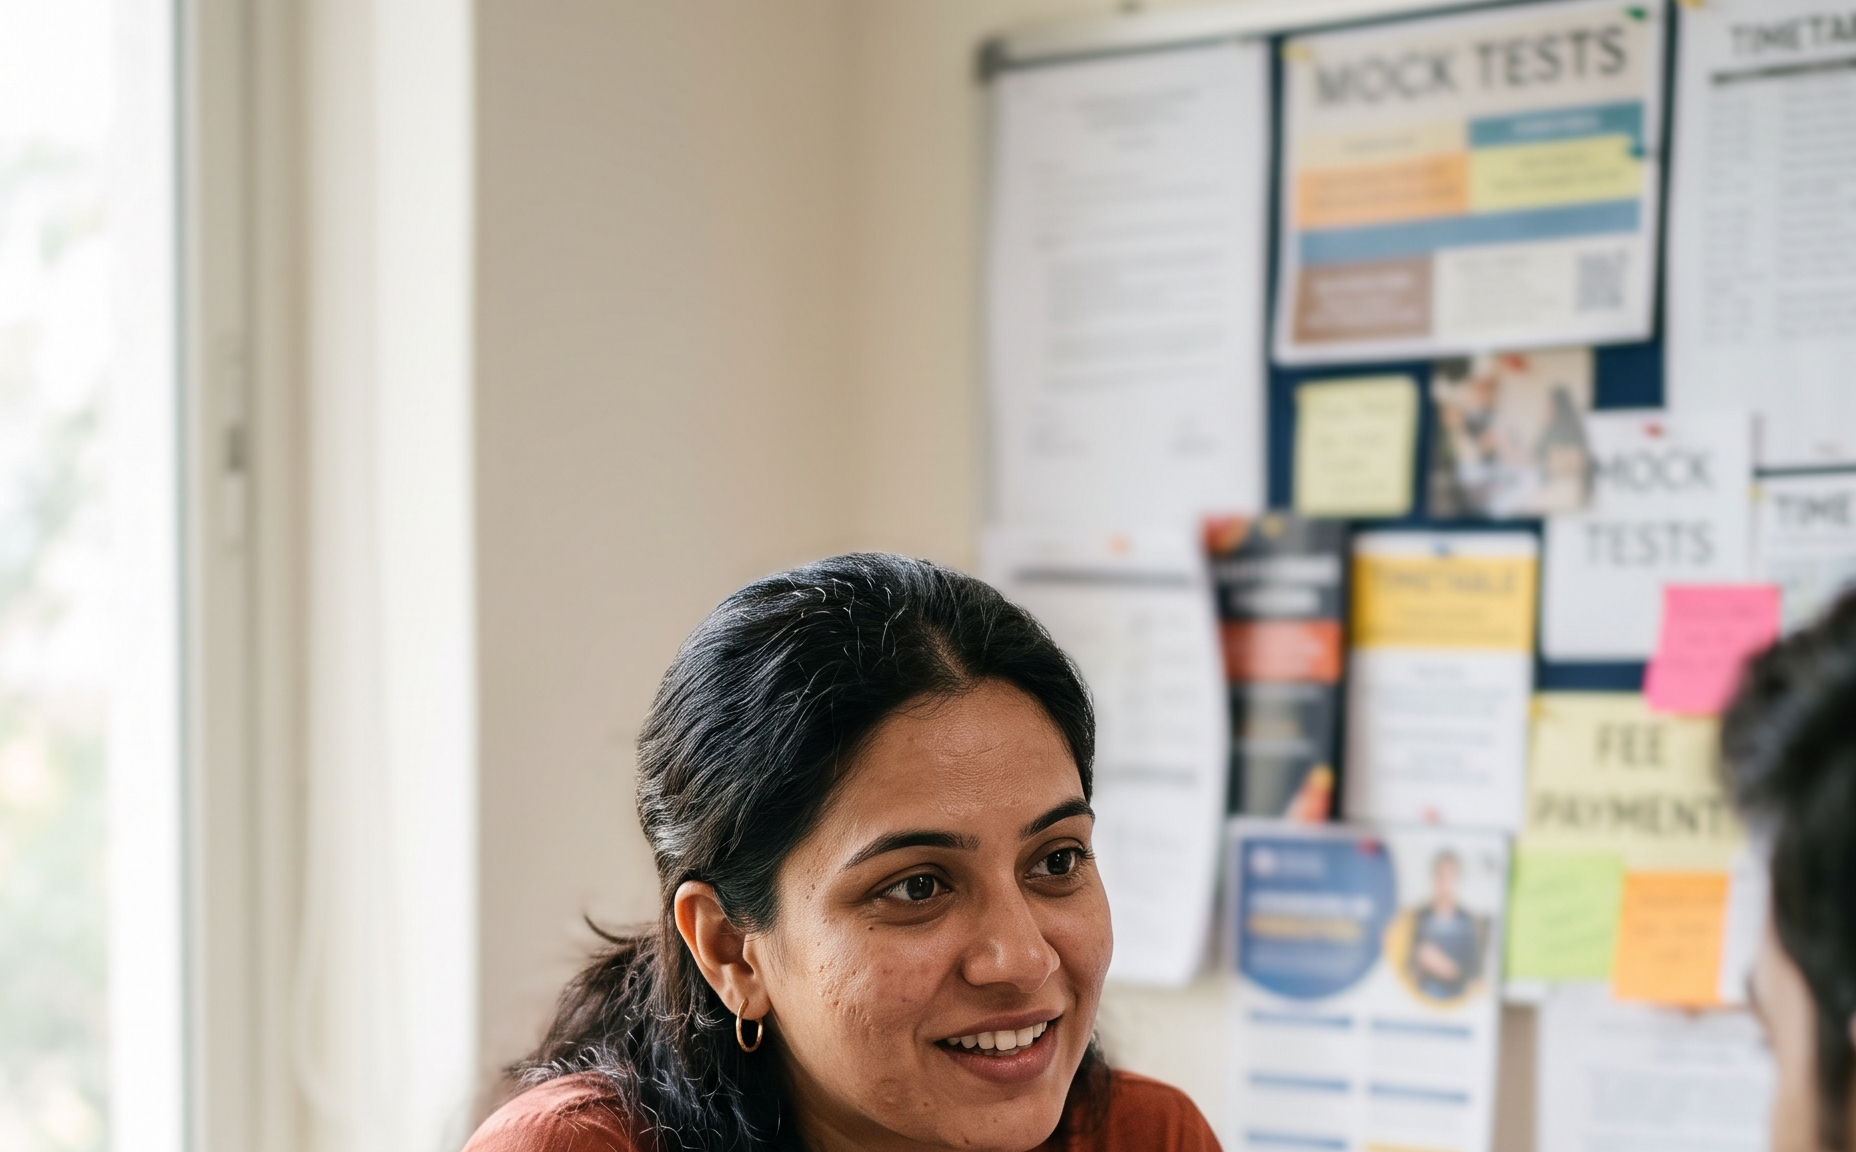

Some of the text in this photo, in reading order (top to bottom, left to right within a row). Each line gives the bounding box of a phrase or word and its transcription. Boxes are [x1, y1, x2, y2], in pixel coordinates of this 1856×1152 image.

[1313, 26, 1628, 105] MOCK TESTS
[1587, 522, 1716, 569] TESTS
[1596, 720, 1667, 768] FEE
